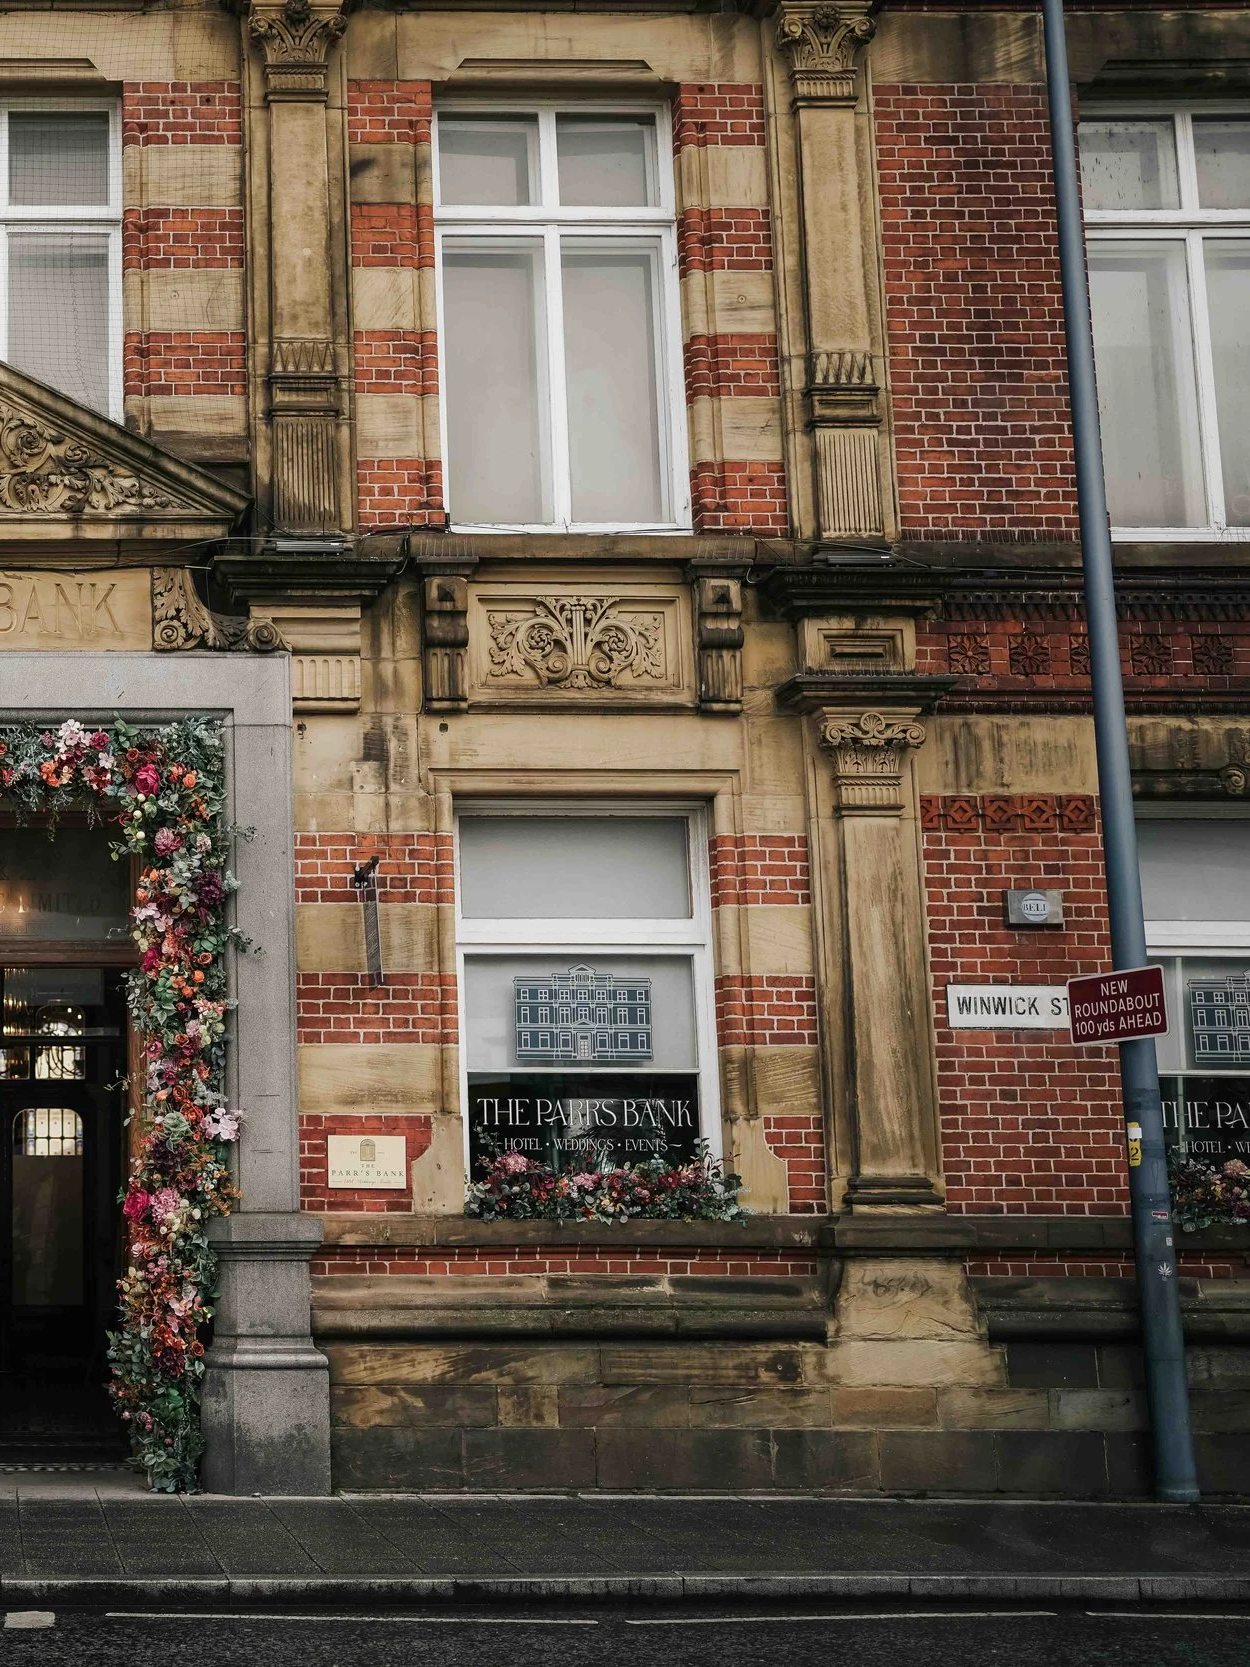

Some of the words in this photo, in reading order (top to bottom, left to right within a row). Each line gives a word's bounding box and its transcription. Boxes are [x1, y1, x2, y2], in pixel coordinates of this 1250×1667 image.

[1100, 979, 1128, 997] NEW
[956, 996, 1040, 1016] WINWICK
[1074, 993, 1160, 1018] ROUNDABOUT
[1075, 1020, 1095, 1036] 100
[1096, 1018, 1115, 1036] yds
[1119, 1011, 1162, 1031] AHEAD
[477, 1098, 530, 1126] THE
[623, 1099, 694, 1128] BANK
[1161, 1101, 1210, 1129] THE
[1215, 1101, 1250, 1129] PA
[504, 1137, 543, 1151] HOTEL
[553, 1137, 615, 1151] WEDDINGS
[624, 1138, 669, 1152] EVENTS
[1185, 1140, 1226, 1153] HOTEL
[331, 1169, 370, 1177] PARR'S
